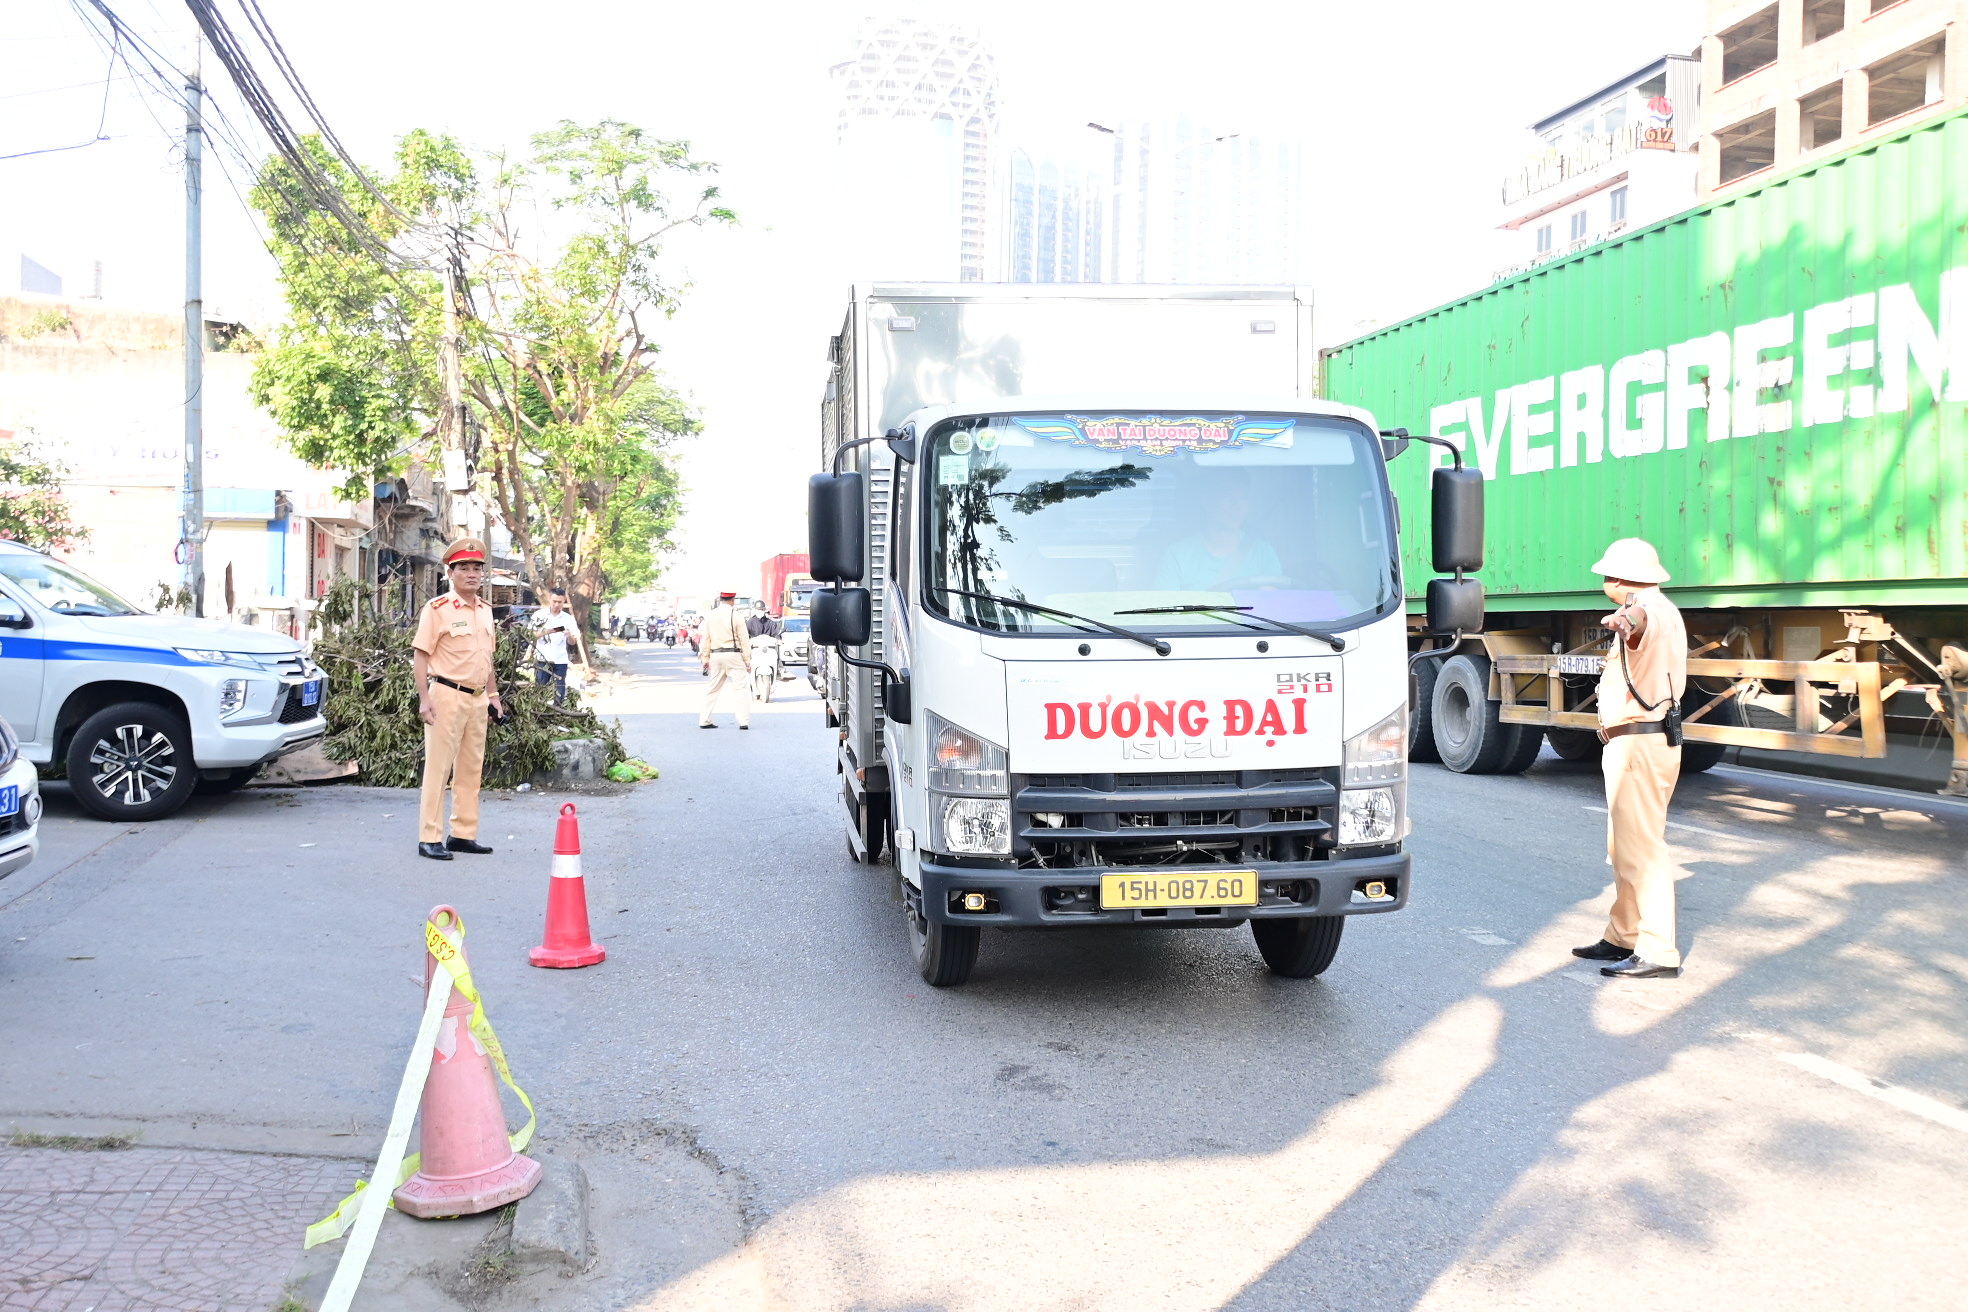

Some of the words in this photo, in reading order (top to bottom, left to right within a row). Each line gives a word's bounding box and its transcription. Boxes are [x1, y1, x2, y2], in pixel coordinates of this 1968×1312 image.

[1645, 127, 1673, 142] 617
[1430, 266, 1968, 490] EVERGREEN
[1276, 672, 1332, 683] QKR
[1277, 683, 1332, 694] 210
[1044, 694, 1209, 740] DƯƠNG
[1223, 698, 1307, 747] ĐẠI
[1123, 738, 1233, 760] ISUZU
[1119, 878, 1243, 901] 15H-087.60
